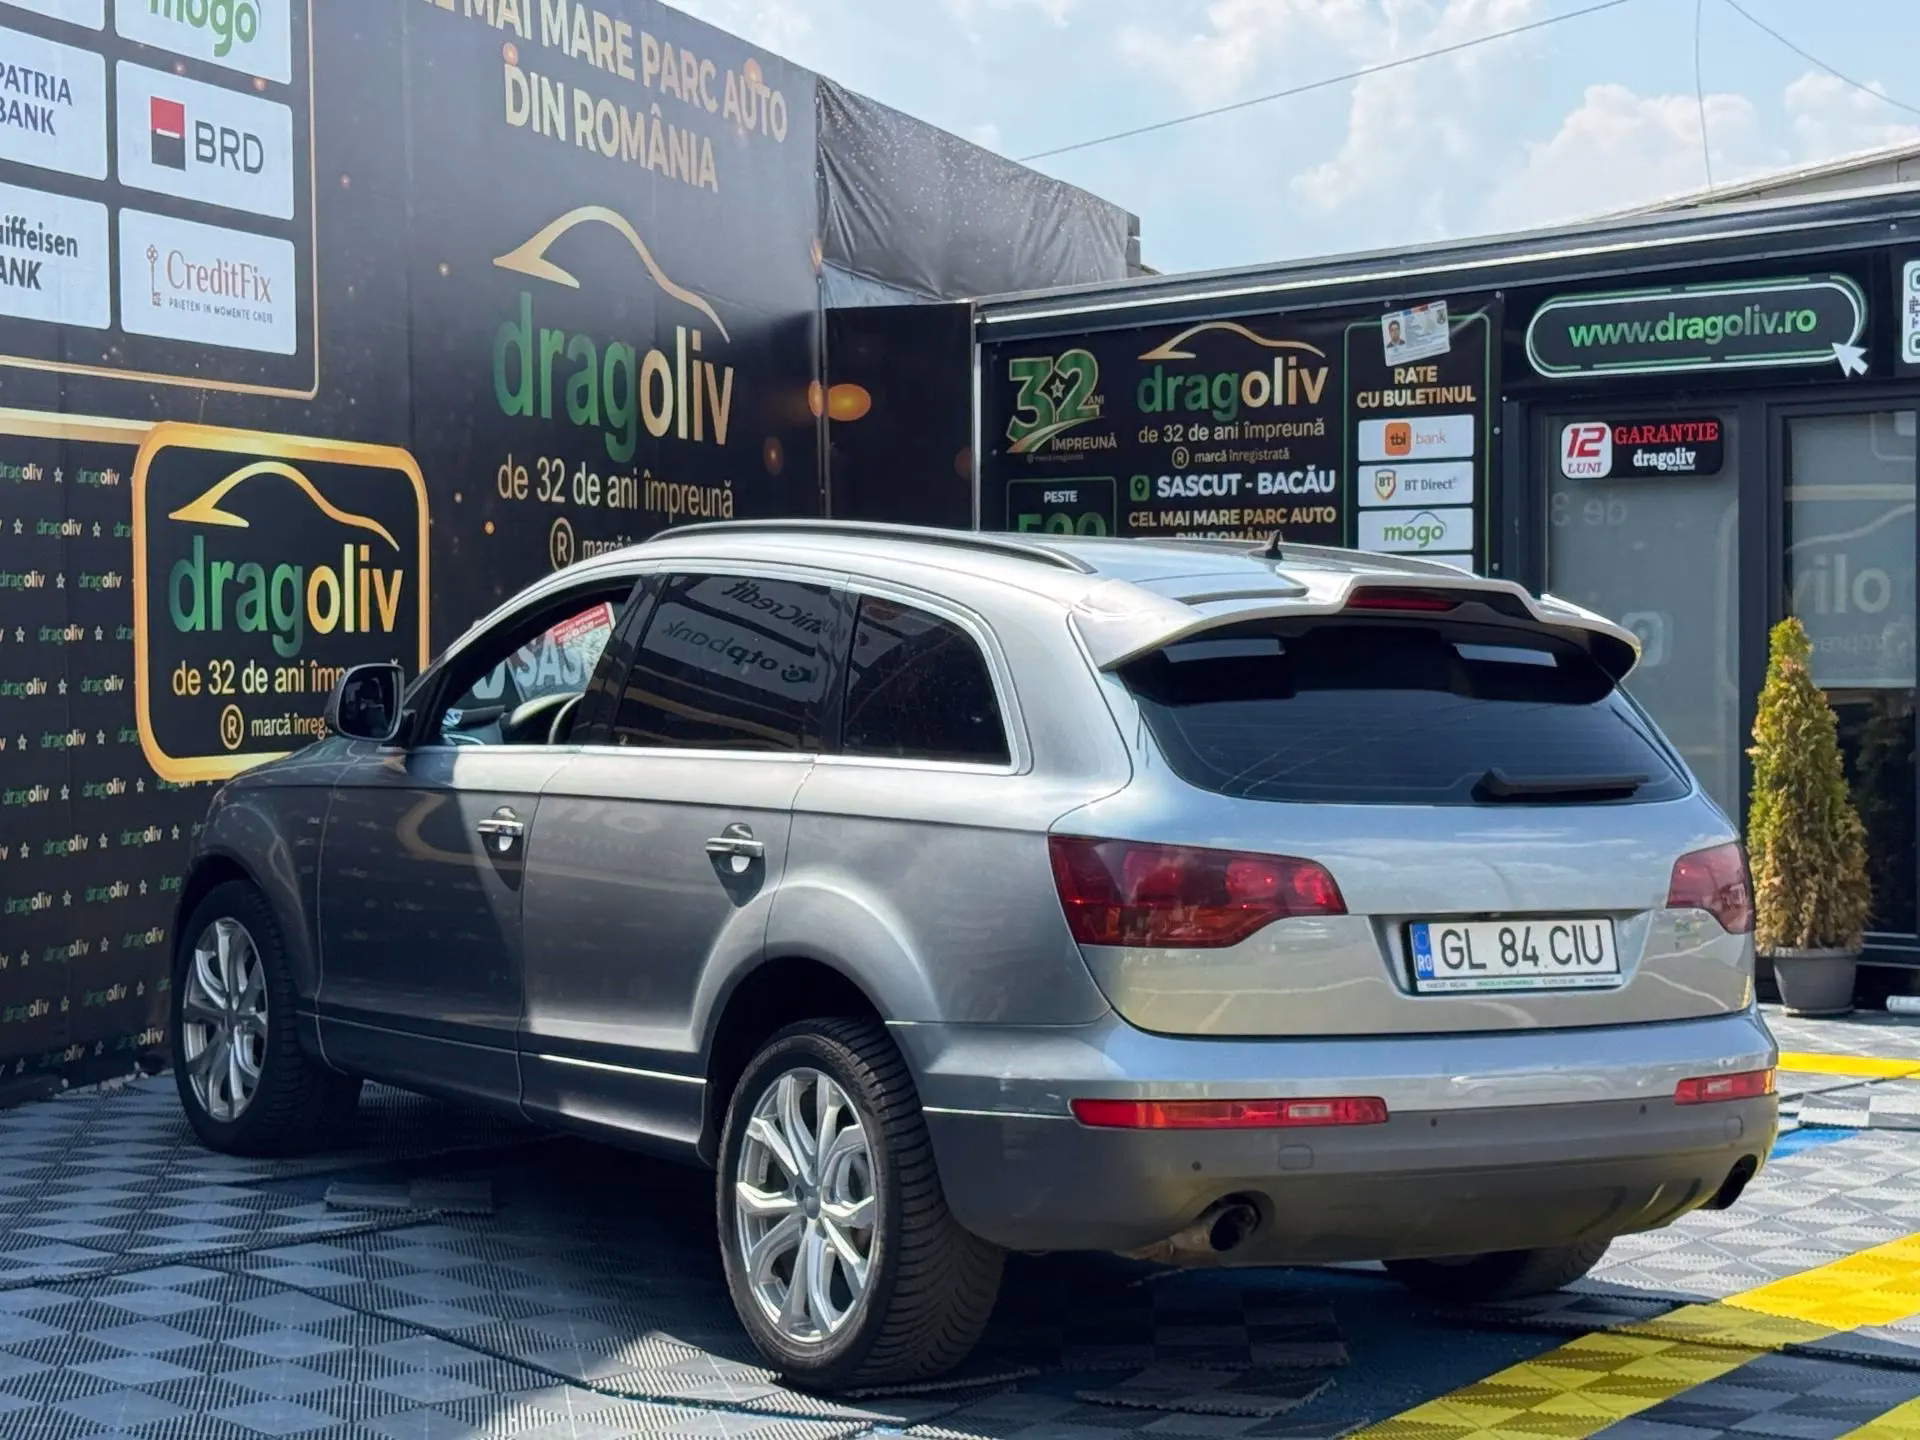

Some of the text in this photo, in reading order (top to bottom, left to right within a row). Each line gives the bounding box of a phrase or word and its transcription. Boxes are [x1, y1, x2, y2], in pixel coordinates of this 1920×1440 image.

[540, 0, 636, 81] MARE
[641, 31, 719, 114] PARC
[723, 69, 789, 143] AUTO
[504, 63, 719, 194] DIN ROMÂNIA
[195, 120, 264, 174] BRD
[167, 249, 272, 304] CreditFix
[1568, 304, 1817, 347] www.dragoliv.ro
[493, 291, 734, 463] dragoliv
[1394, 366, 1437, 385] RATE
[1006, 348, 1099, 442] 32
[1137, 356, 1329, 422] dragoliv
[1357, 385, 1476, 408] CU BULETINUL
[1138, 418, 1325, 443] de 32 de ani împreună
[1416, 430, 1447, 445] bank
[1567, 422, 1718, 458] 12 GARANTIE
[1567, 462, 1602, 474] LUNI
[1633, 447, 1696, 470] dragoliv
[76, 466, 120, 488] dragoliv
[498, 453, 734, 524] de 32 de ani împreună
[1157, 473, 1242, 498] SASCUT
[1257, 465, 1335, 495] BACĂU
[1379, 476, 1392, 489] BT
[1404, 478, 1419, 491] BT
[1043, 490, 1078, 503] PESTE
[36, 518, 82, 539] dragoliv
[1128, 506, 1336, 527] CEL MAI MARE PARC AUTO
[1383, 523, 1444, 548] mogo
[79, 571, 122, 592] dragoliv
[169, 535, 403, 657] dragoliv
[39, 624, 84, 646] dragoliv
[1, 674, 124, 700] dragoliv dragoliv
[172, 660, 201, 696] de
[208, 659, 235, 695] 32
[242, 660, 268, 694] de
[275, 661, 305, 693] ani
[251, 713, 292, 737] marcă
[41, 728, 86, 751] dragoliv
[4, 785, 49, 807] dragoliv
[82, 777, 126, 799] dragoliv
[43, 825, 162, 857] dragoliv dragoliv
[5, 891, 52, 915] dragoliv
[85, 880, 129, 903] dragoliv
[1440, 924, 1604, 970] GL 84 CIU
[1418, 954, 1433, 971] RO
